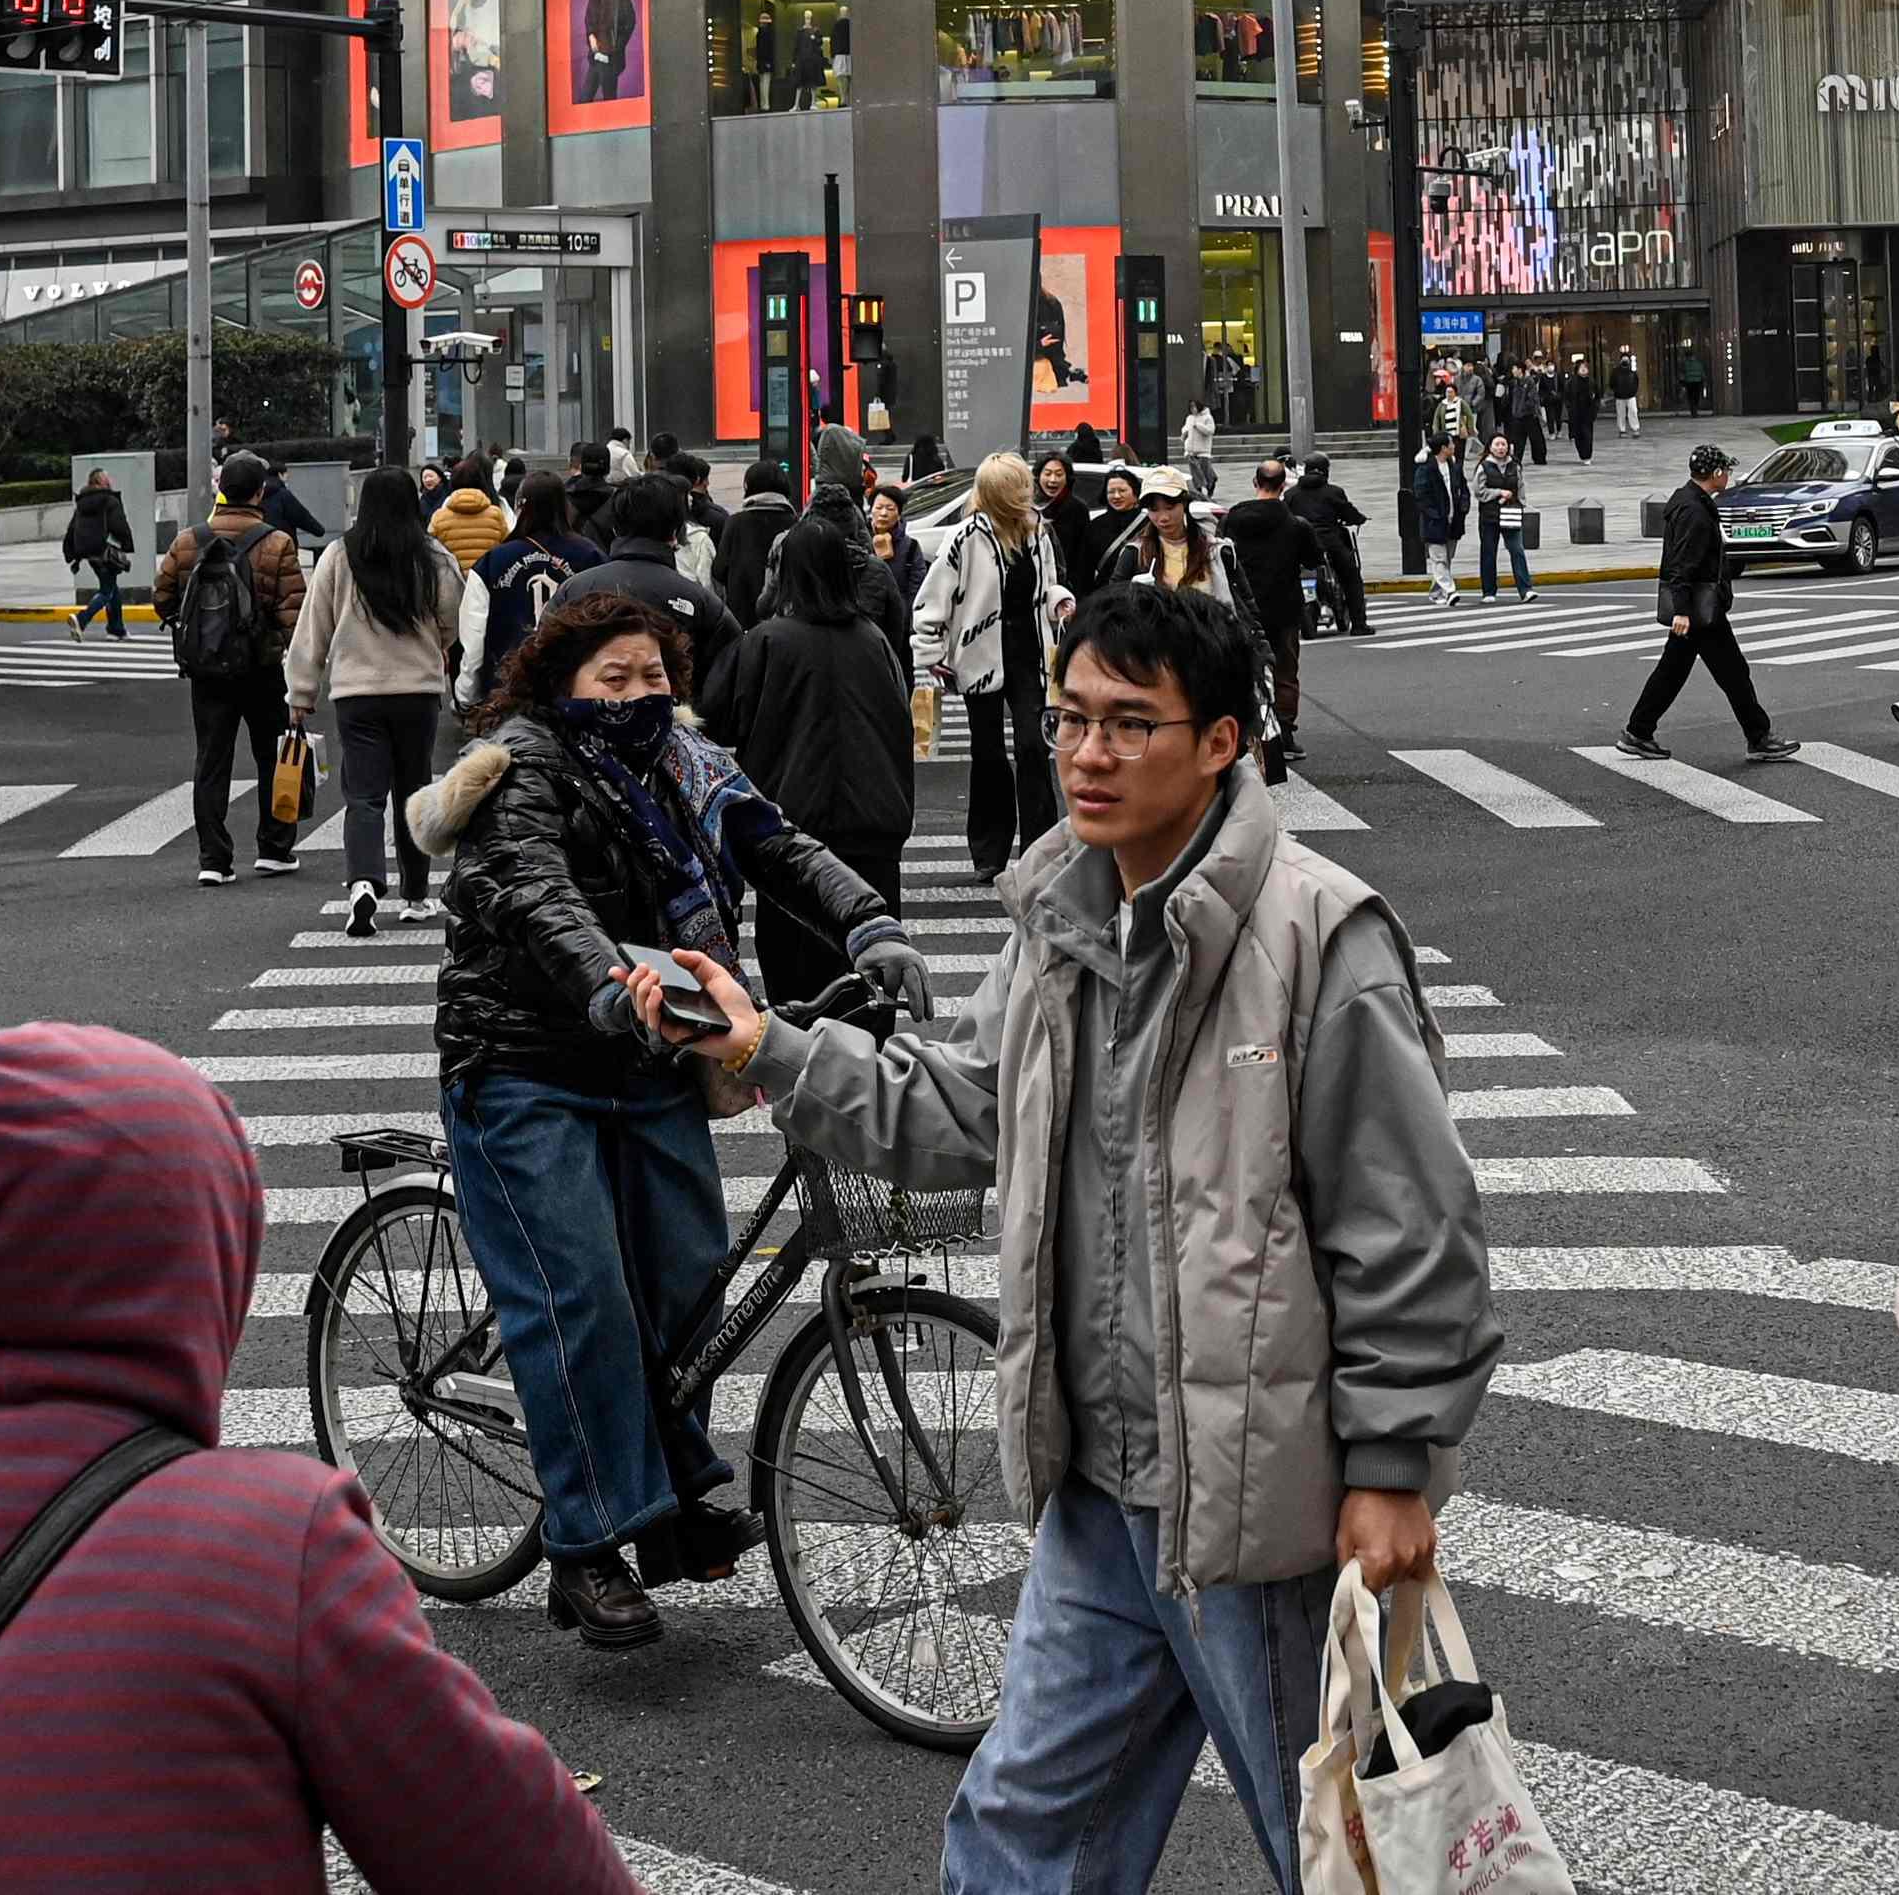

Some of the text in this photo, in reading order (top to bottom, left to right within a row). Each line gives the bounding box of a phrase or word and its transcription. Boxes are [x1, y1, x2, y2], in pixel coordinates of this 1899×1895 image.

[1215, 194, 1309, 217] PRA
[567, 234, 584, 251] 10
[955, 280, 977, 317] P
